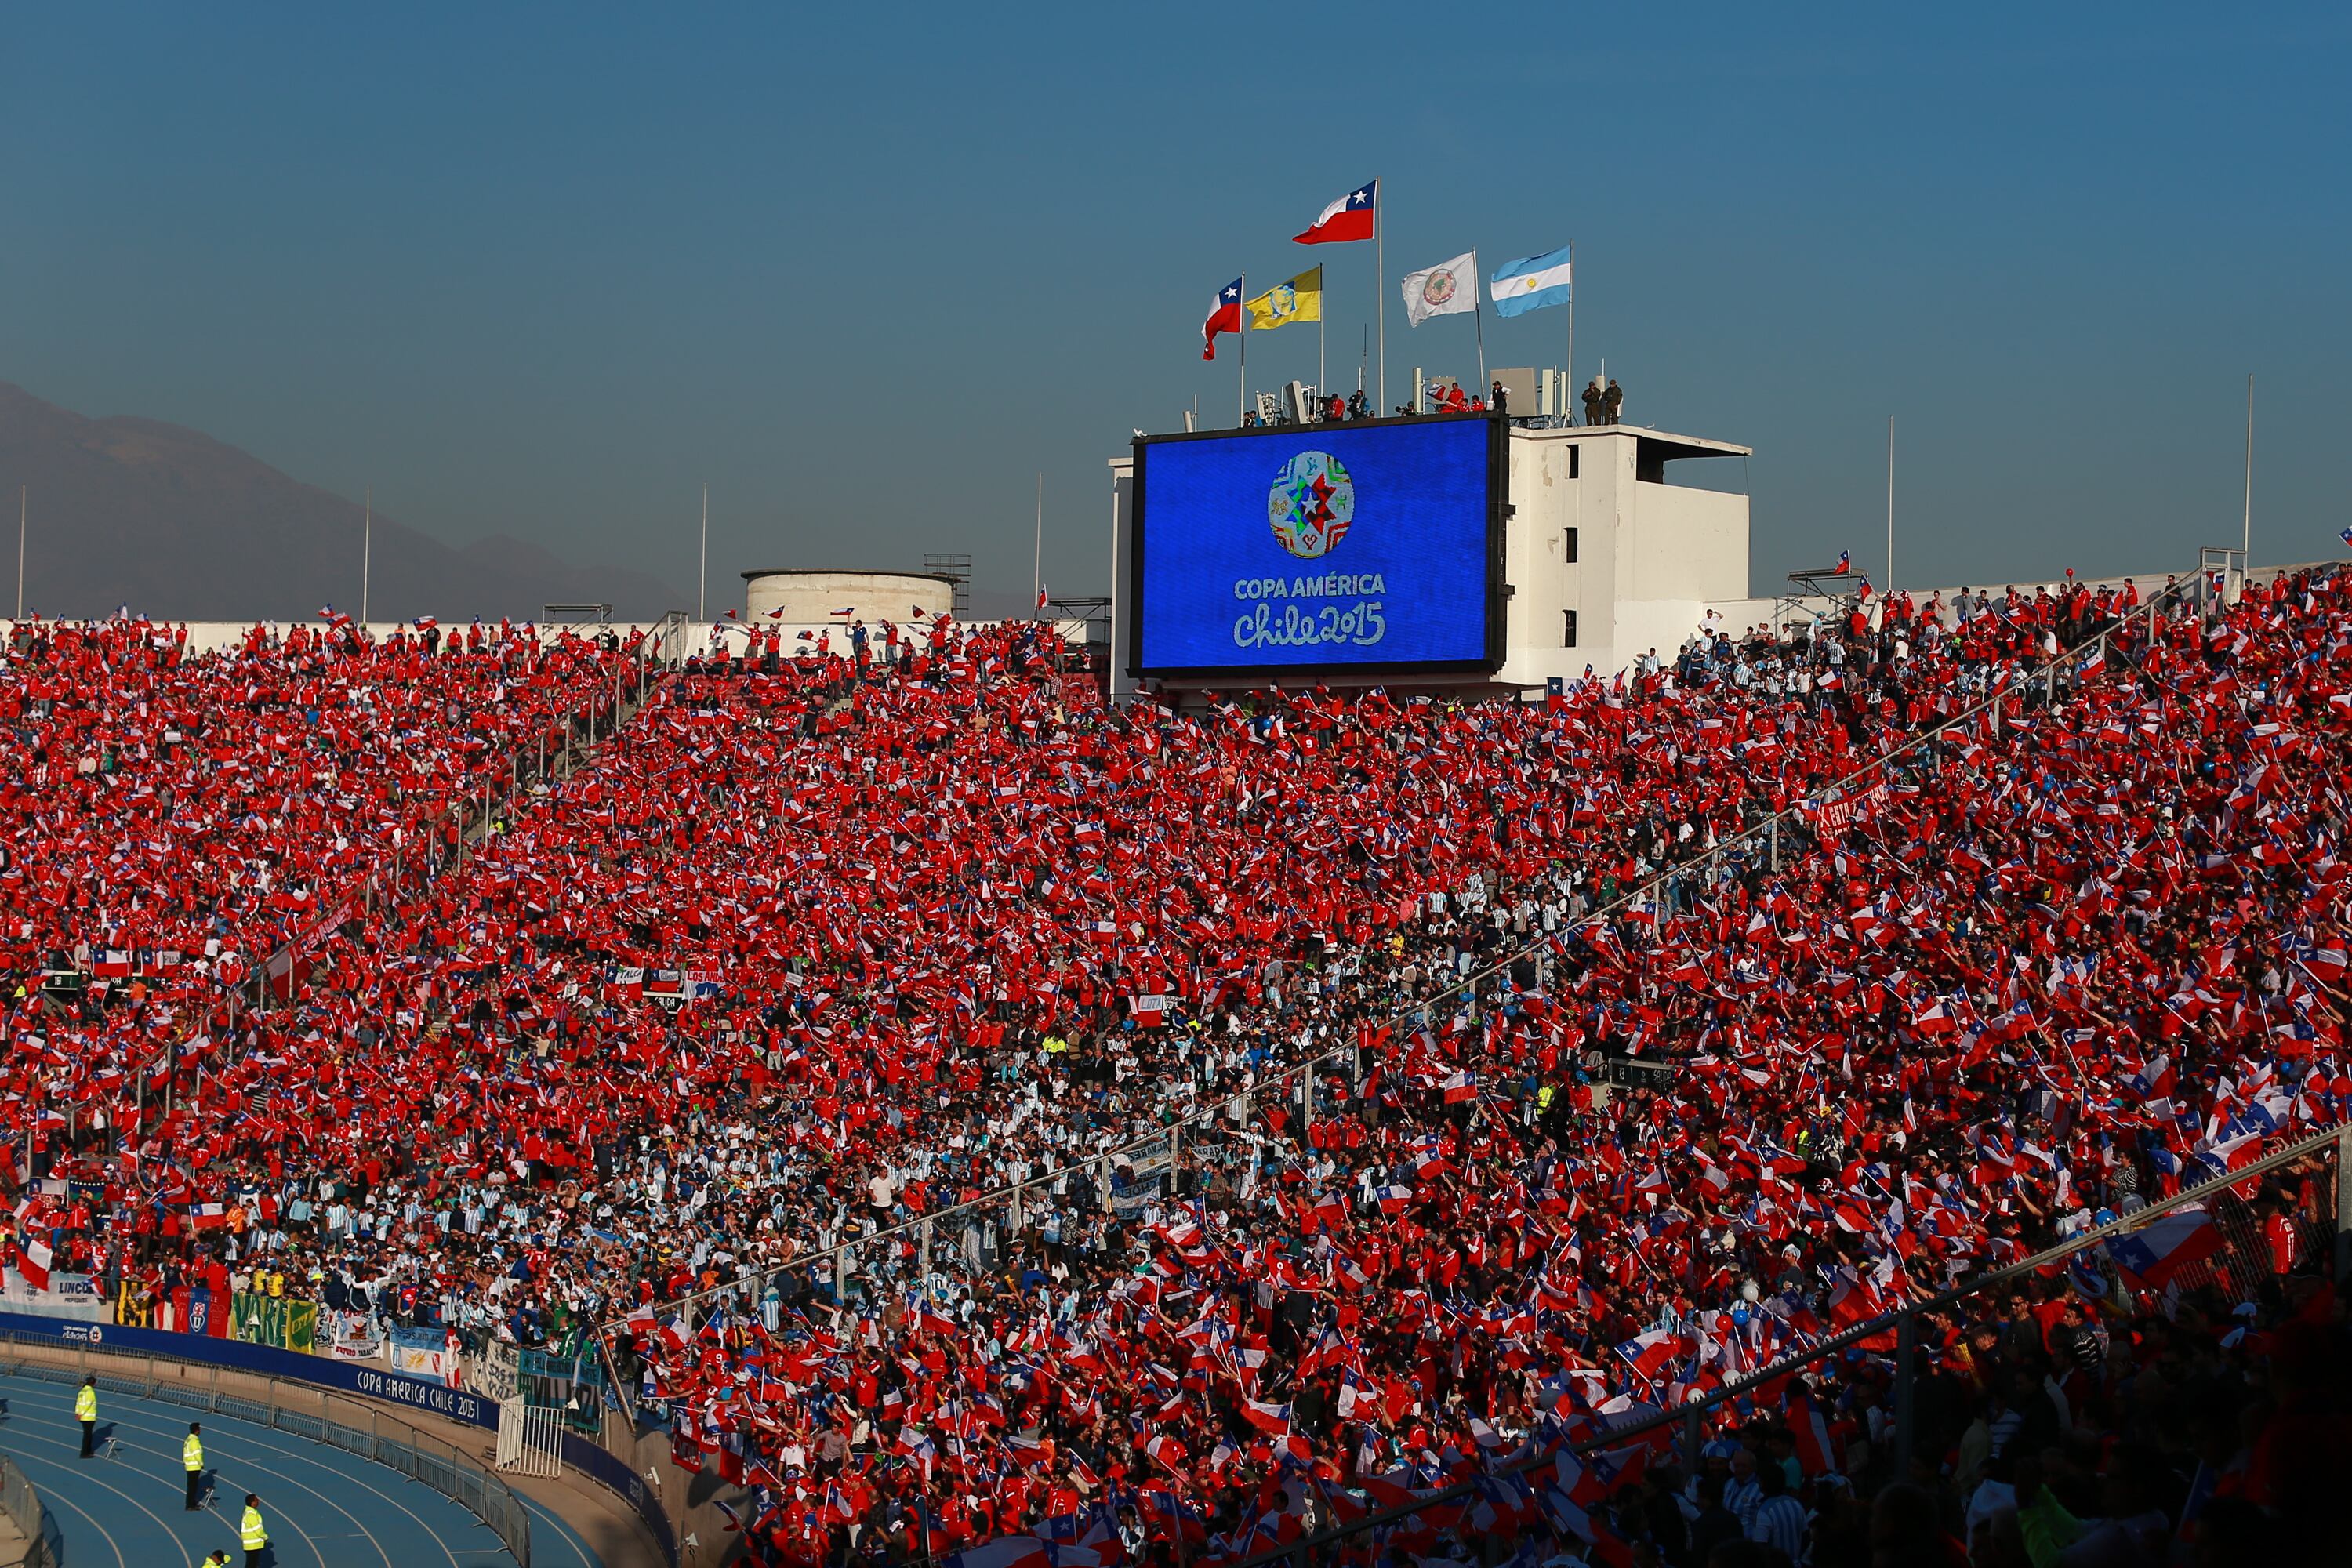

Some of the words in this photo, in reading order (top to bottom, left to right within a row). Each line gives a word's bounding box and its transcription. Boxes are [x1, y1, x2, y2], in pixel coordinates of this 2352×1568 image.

[1234, 577, 1288, 600] COPA
[1290, 571, 1386, 597] AMÉRICA
[688, 970, 703, 981] LOS
[193, 1316, 201, 1329] U
[716, 1353, 723, 1363] 9
[358, 1370, 382, 1394] COPA
[386, 1378, 426, 1405] AMERICA
[430, 1388, 453, 1412] CHILE
[458, 1396, 475, 1419] 2015
